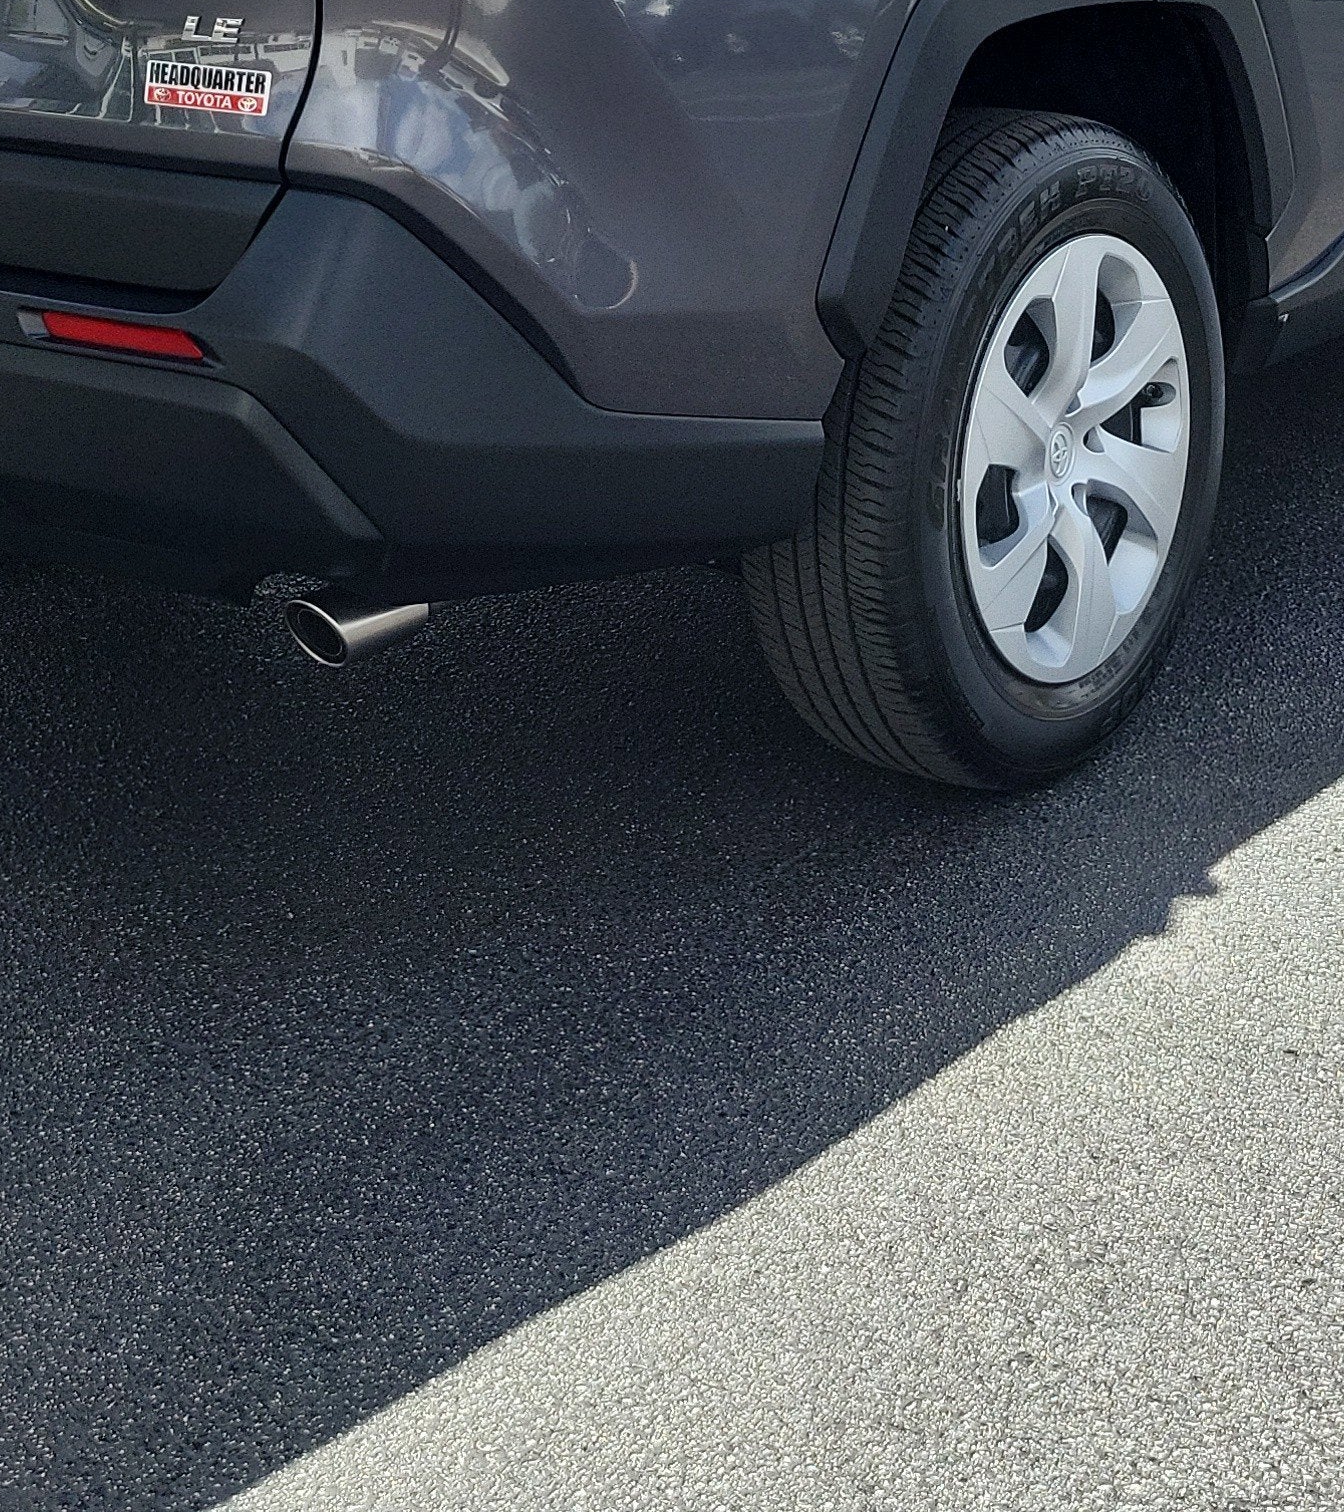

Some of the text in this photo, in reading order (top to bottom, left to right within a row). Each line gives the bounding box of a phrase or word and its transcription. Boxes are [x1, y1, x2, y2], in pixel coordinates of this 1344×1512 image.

[181, 15, 245, 44] LE
[149, 62, 266, 95] HEADQUARTER
[176, 90, 233, 110] TOYOTA
